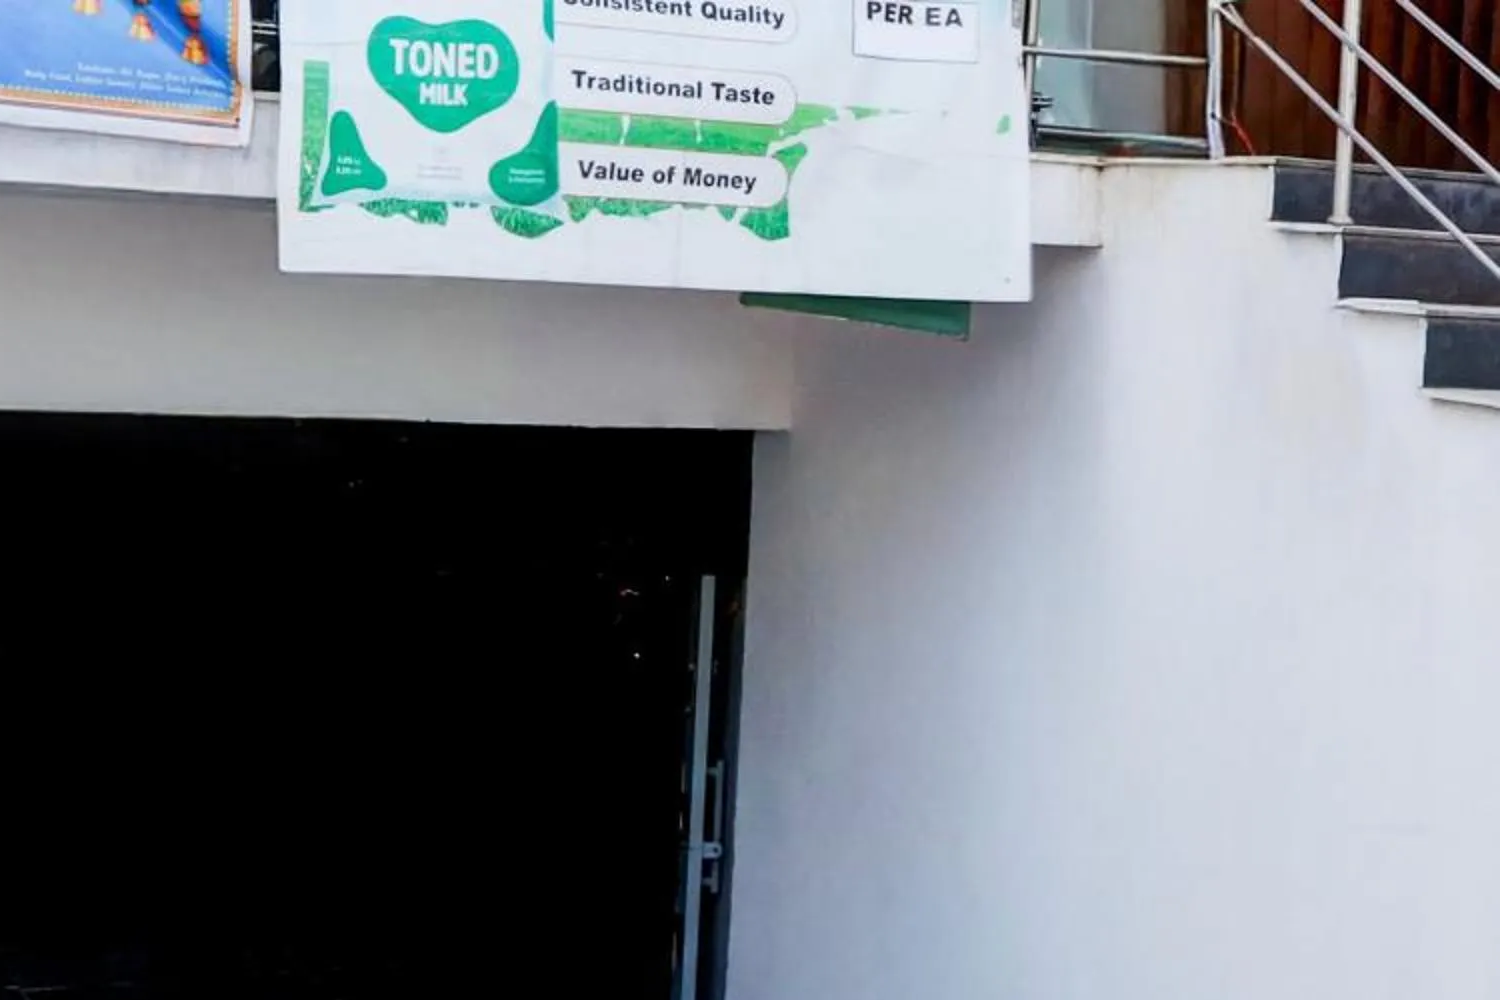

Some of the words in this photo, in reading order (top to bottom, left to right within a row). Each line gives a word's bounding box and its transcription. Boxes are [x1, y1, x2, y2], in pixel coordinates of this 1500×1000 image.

[563, 0, 692, 17] onsistent
[700, 1, 785, 30] Quality
[867, 1, 913, 25] PER
[925, 7, 963, 27] EA
[389, 38, 499, 79] TONED
[419, 83, 468, 106] MILK
[571, 69, 703, 100] Traditional
[710, 81, 775, 106] Taste
[578, 159, 645, 183] Value
[652, 165, 677, 185] of
[682, 167, 757, 195] Money
